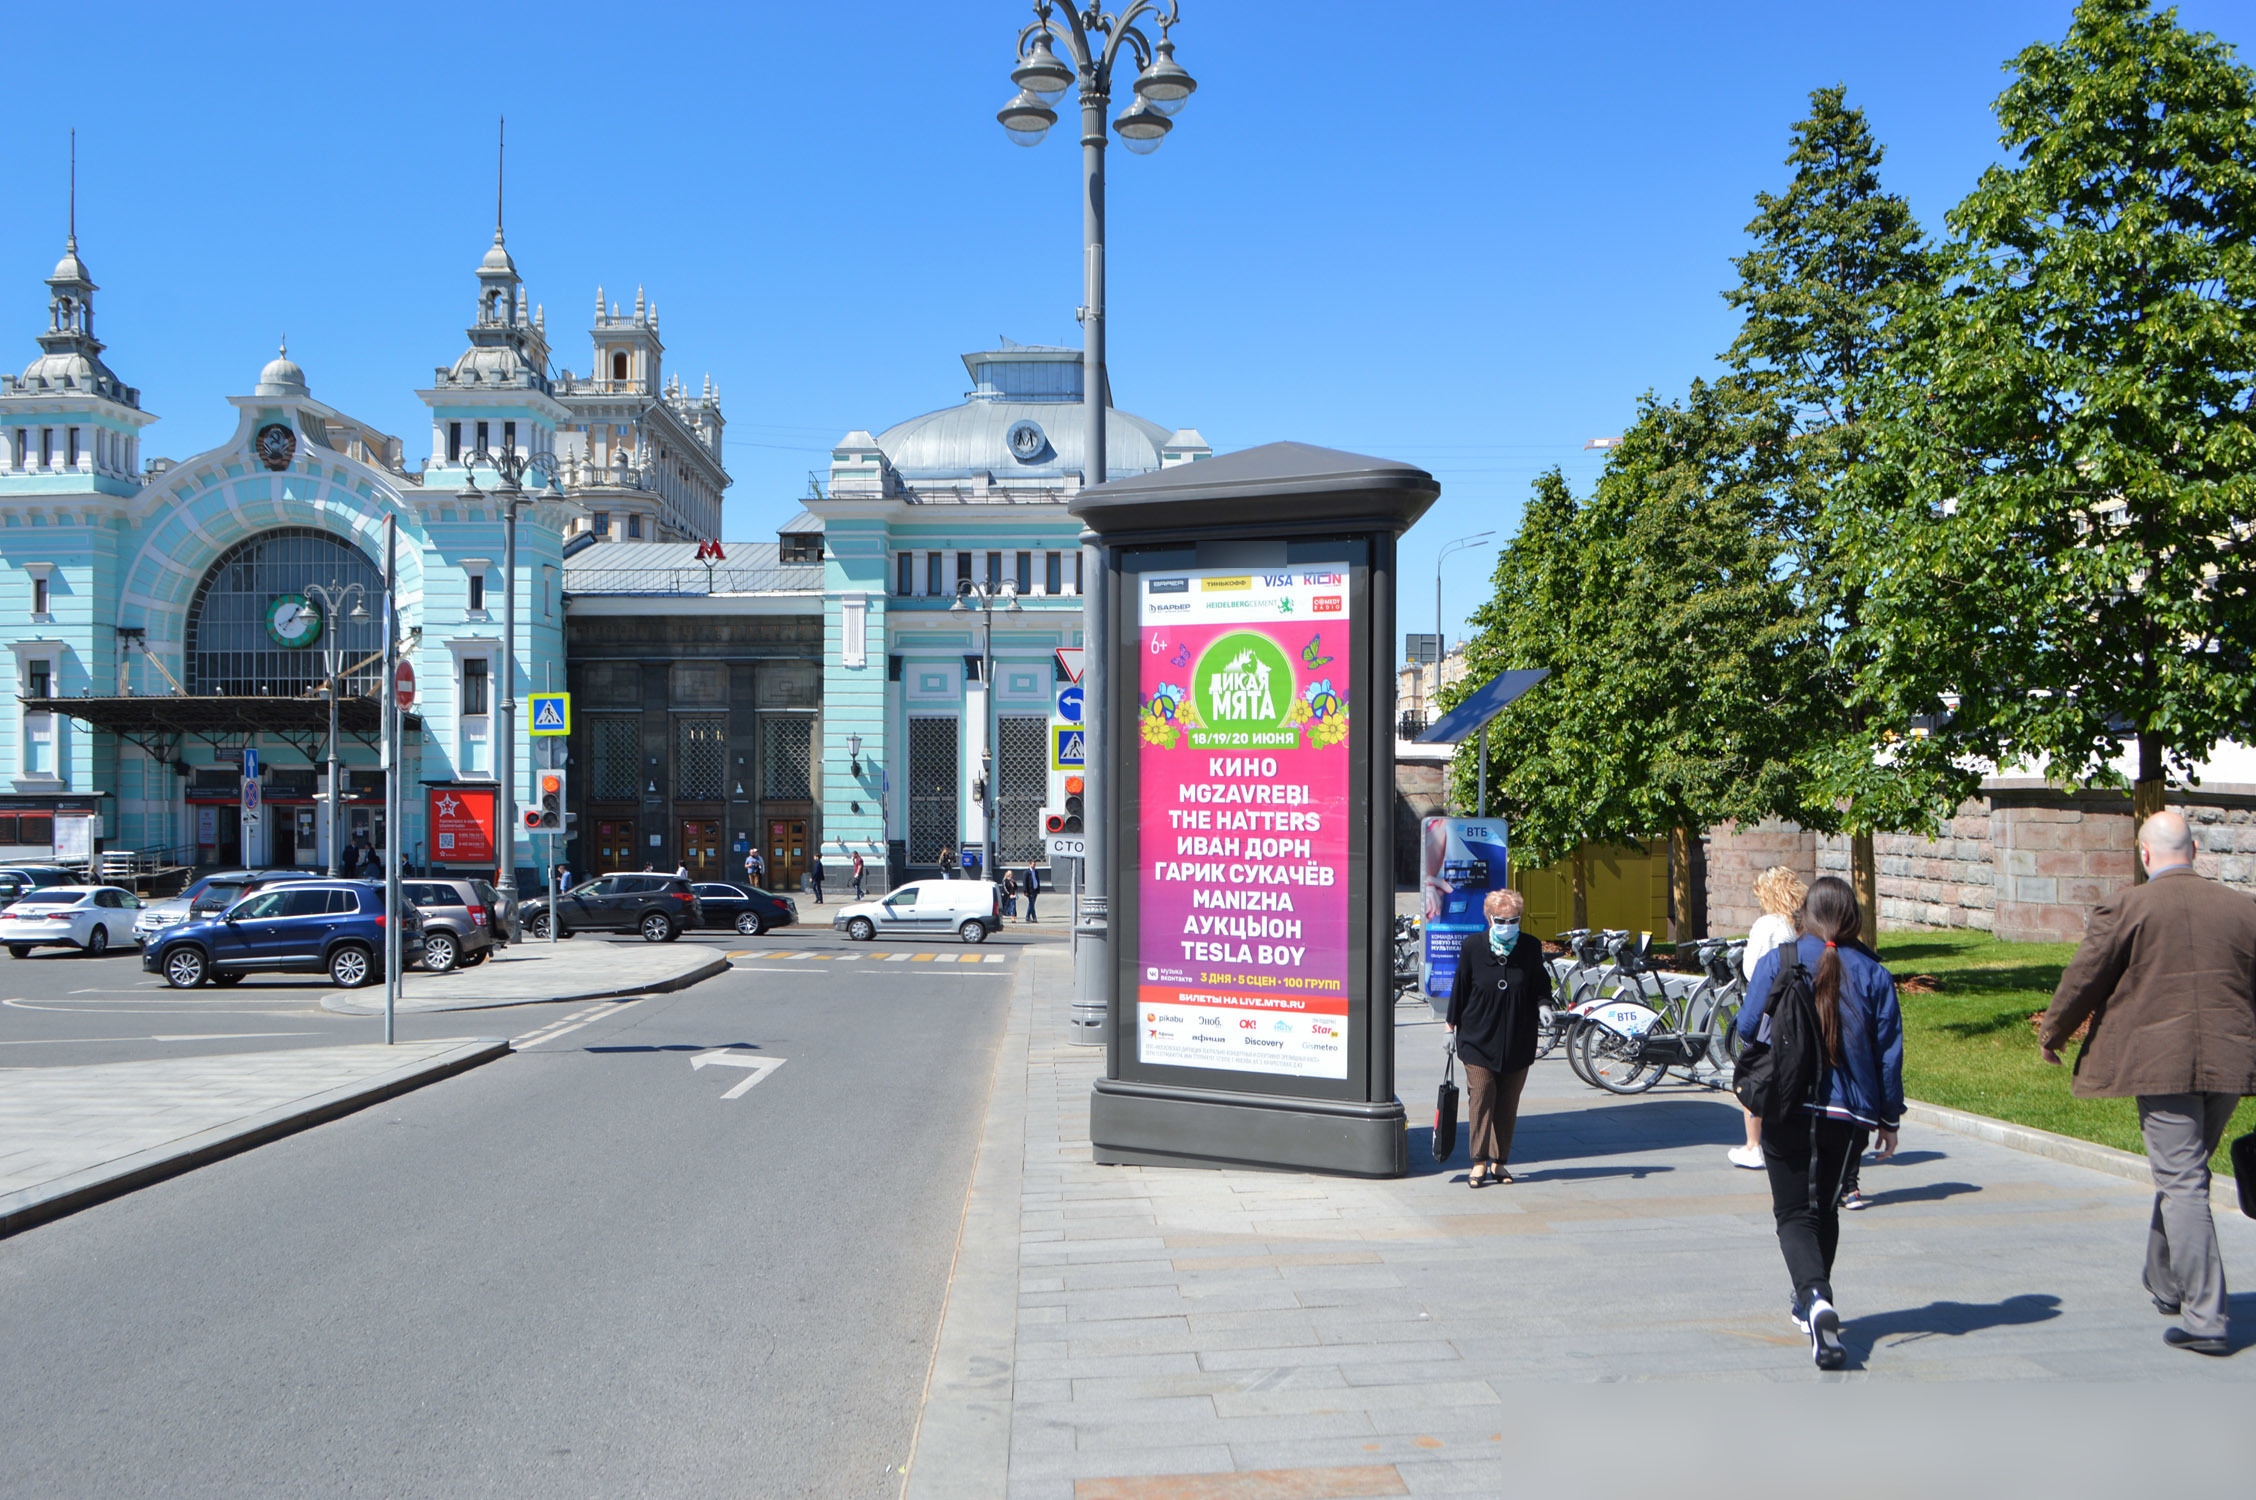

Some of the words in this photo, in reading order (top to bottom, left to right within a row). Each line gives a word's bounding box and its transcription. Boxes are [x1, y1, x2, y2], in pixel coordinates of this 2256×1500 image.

[694, 538, 726, 559] М
[1264, 575, 1293, 587] VISA
[1304, 574, 1342, 585] KION
[1157, 604, 1191, 612] БАРЬЕР
[1206, 600, 1277, 609] HEIDELBERGCEMENT
[1151, 632, 1168, 654] 6+
[1209, 673, 1270, 695] ДИКАЯ
[1212, 690, 1276, 720] МЯТА
[1192, 733, 1249, 745] 18/19/20
[1252, 733, 1294, 745] ИЮНЯ
[1209, 758, 1277, 777] КИНО
[1179, 784, 1309, 804] MGZAVREBI
[1169, 810, 1211, 829] THE
[1217, 811, 1321, 831] HATTERS
[1467, 827, 1487, 837] ВТБ
[1177, 837, 1240, 857] ИВАН
[1245, 839, 1310, 860] ДОРН
[1155, 862, 1225, 882] ГАРИК
[1229, 860, 1335, 886] СУКАЧЁВ
[1193, 889, 1294, 911] MANIZHA
[1184, 915, 1302, 939] АУКЦЫОН
[1181, 941, 1253, 963] TESLA
[1258, 945, 1305, 966] BOY
[1161, 975, 1193, 983] вконтакте
[1200, 972, 1207, 982] 3
[1209, 973, 1231, 984] ДНЯ
[1238, 975, 1245, 984] 5
[1246, 975, 1276, 987] СЦЕН
[1283, 977, 1303, 988] 100
[1305, 979, 1340, 990] ГРУПП
[1179, 993, 1222, 1004] БИЛЕТЫ
[1223, 996, 1238, 1005] НА
[1240, 998, 1305, 1009] LIVE.MTS.RU
[1159, 1015, 1184, 1023] pikabu
[1239, 1019, 1256, 1029] OK!
[1617, 1012, 1637, 1021] ВТБ
[1244, 1037, 1284, 1049] Discovery
[1302, 1042, 1338, 1051] Gismeteo
